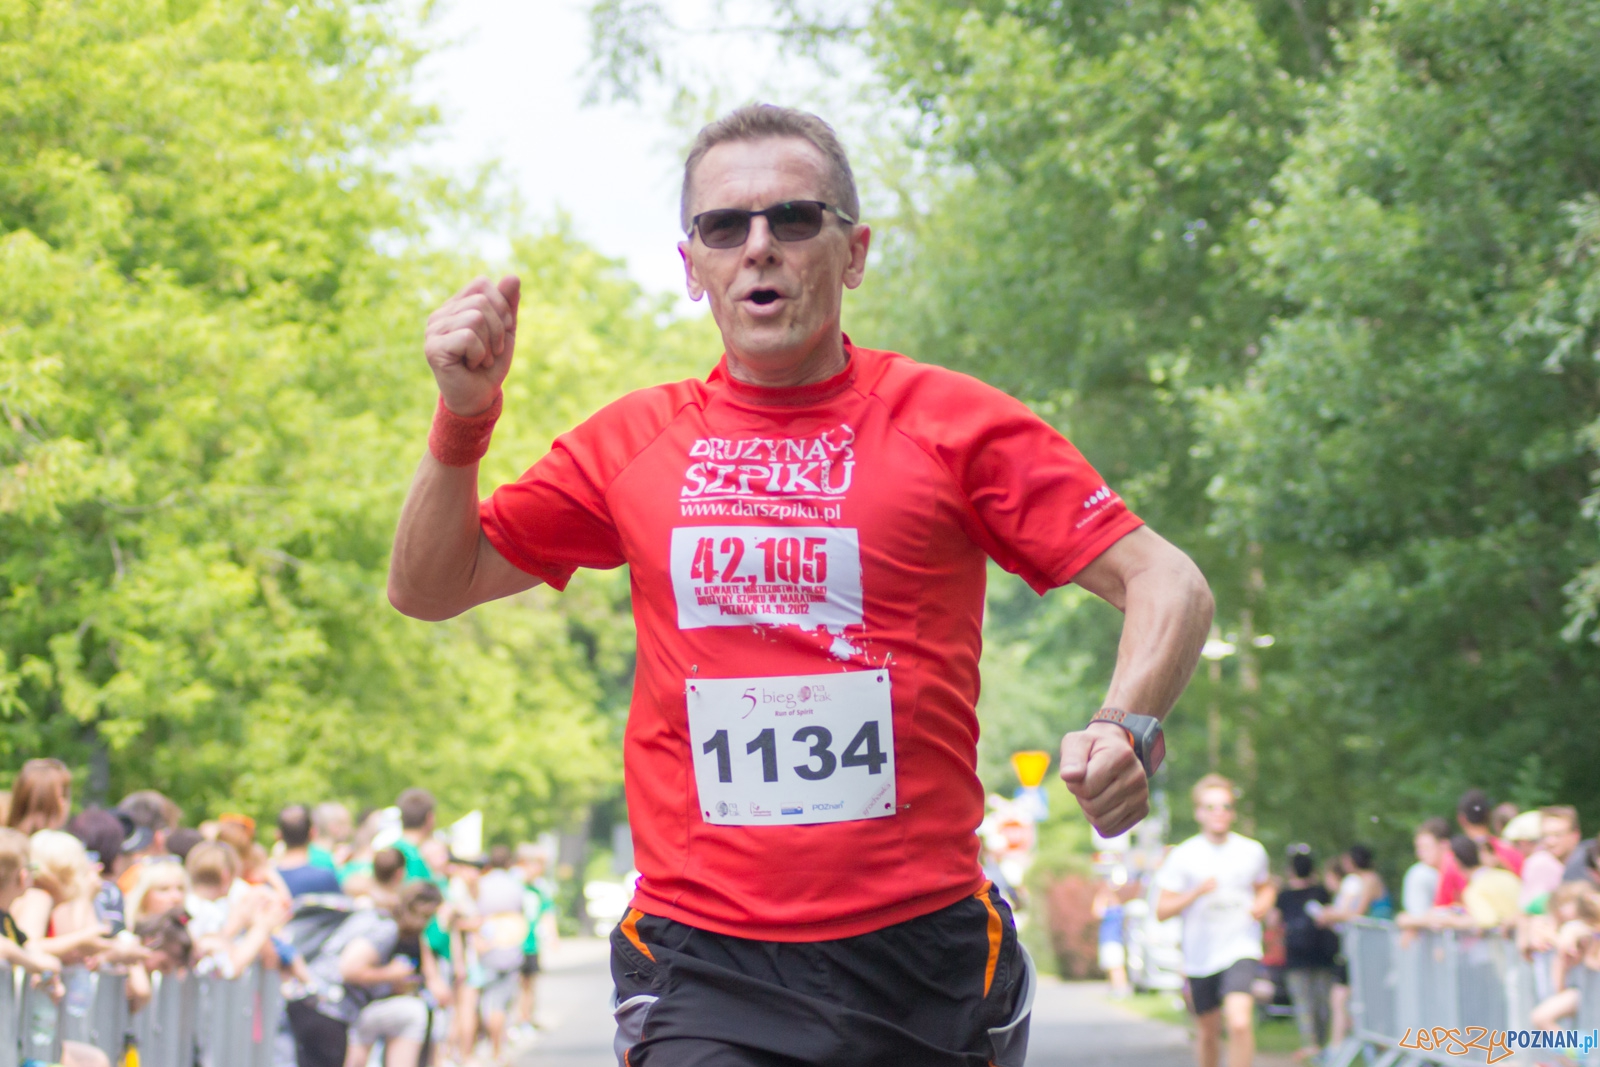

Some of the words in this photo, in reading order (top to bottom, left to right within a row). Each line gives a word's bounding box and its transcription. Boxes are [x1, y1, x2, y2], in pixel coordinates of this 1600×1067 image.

[680, 460, 856, 497] SZPIKU
[680, 500, 841, 522] www.darszpiku.pl
[690, 536, 828, 588] 42,195
[736, 594, 766, 604] SZPIKU
[768, 593, 778, 603] W
[741, 687, 757, 719] 5
[762, 688, 797, 709] bieg
[813, 692, 832, 702] tak
[796, 708, 814, 716] Spirit
[702, 720, 888, 783] 1134
